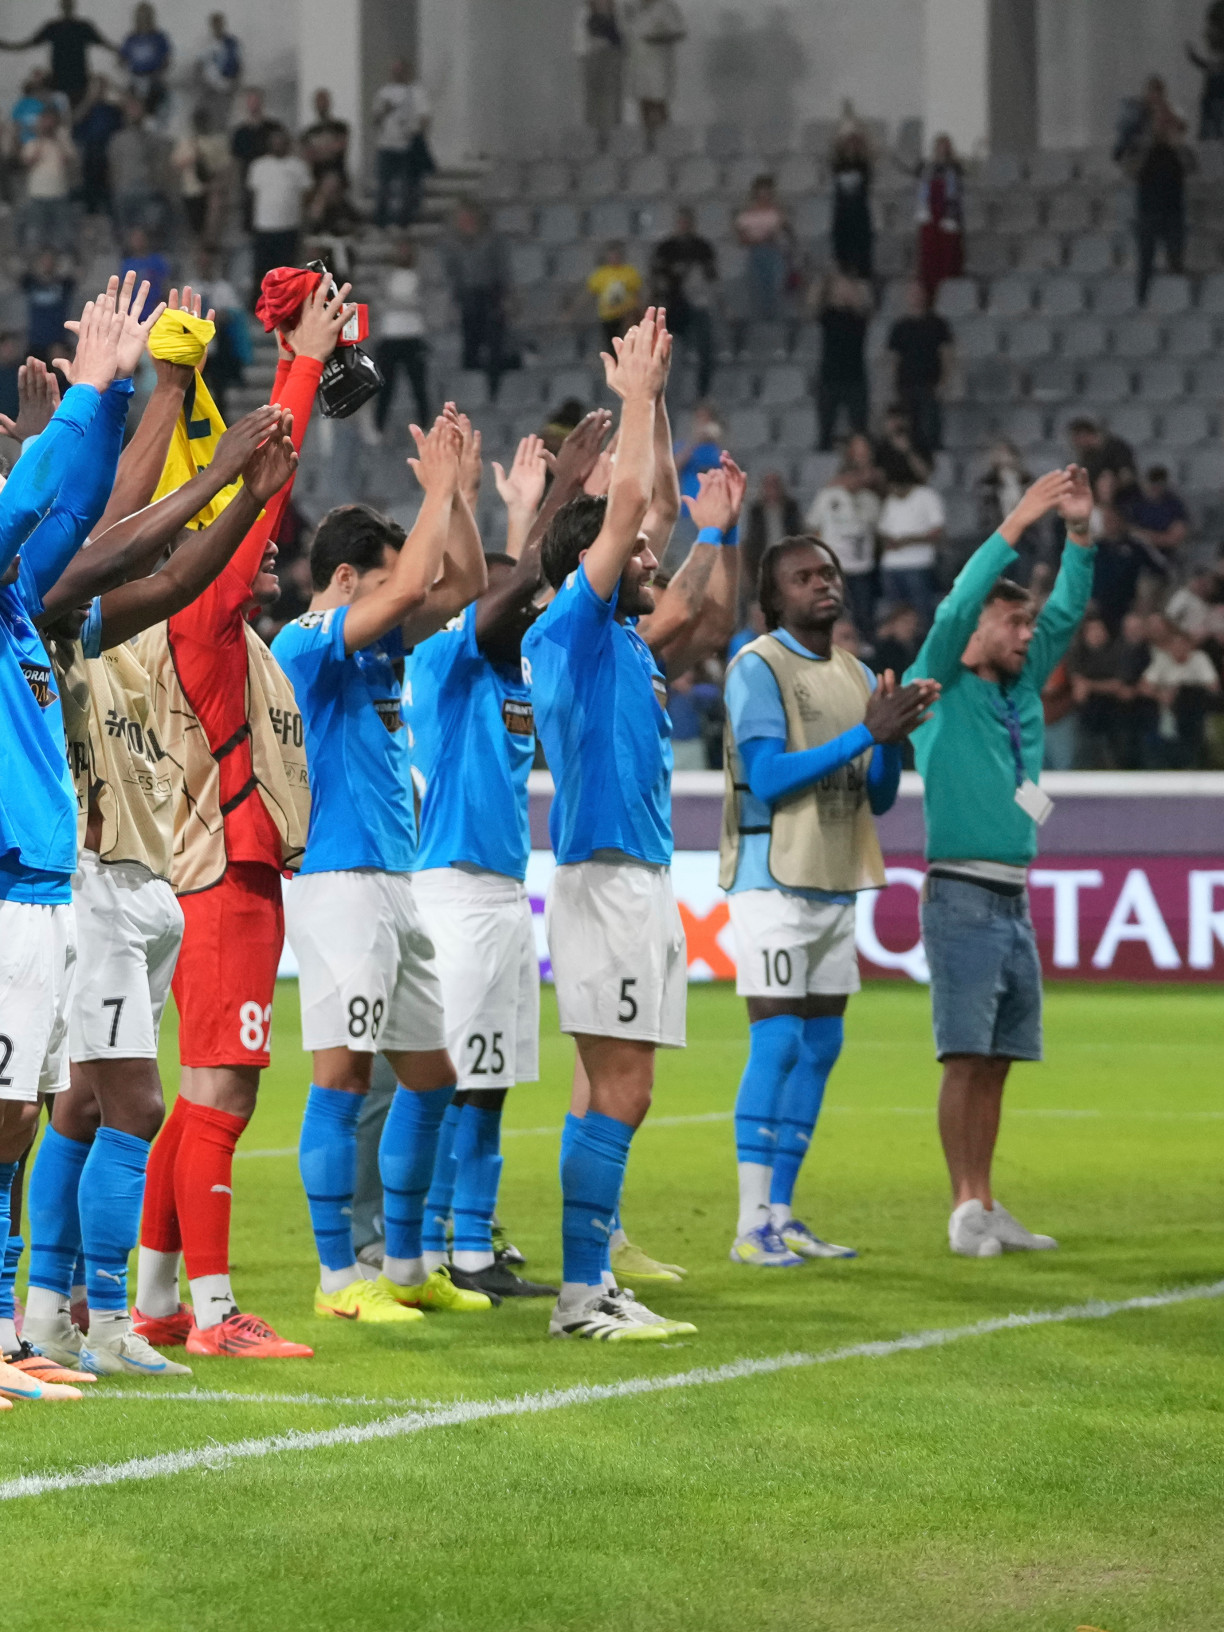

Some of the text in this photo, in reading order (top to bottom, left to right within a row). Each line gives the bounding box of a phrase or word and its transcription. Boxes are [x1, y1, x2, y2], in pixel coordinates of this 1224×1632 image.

[855, 867, 1224, 983] QTAR
[762, 949, 791, 987] 10
[102, 996, 126, 1048] 7
[348, 996, 384, 1040] 88
[617, 977, 638, 1023] 5
[467, 1031, 506, 1075] 25
